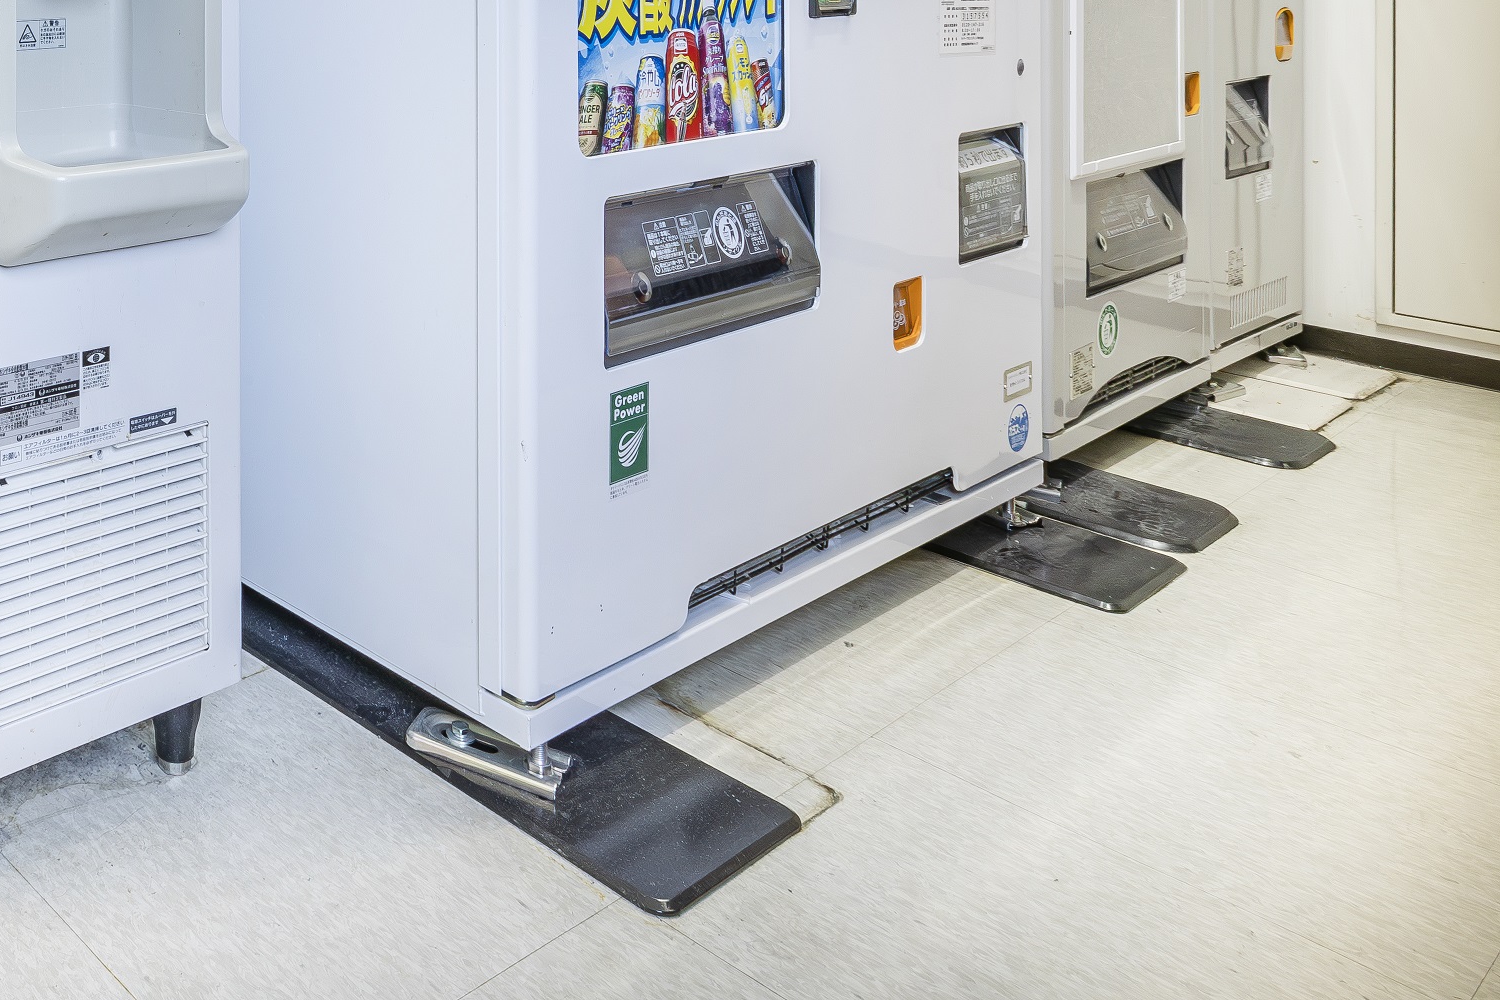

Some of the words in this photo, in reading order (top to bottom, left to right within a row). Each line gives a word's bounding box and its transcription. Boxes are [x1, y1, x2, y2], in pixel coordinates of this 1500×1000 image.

[669, 65, 698, 107] Cola
[579, 115, 593, 124] ALE
[614, 390, 645, 408] Green
[613, 403, 646, 421] Power
